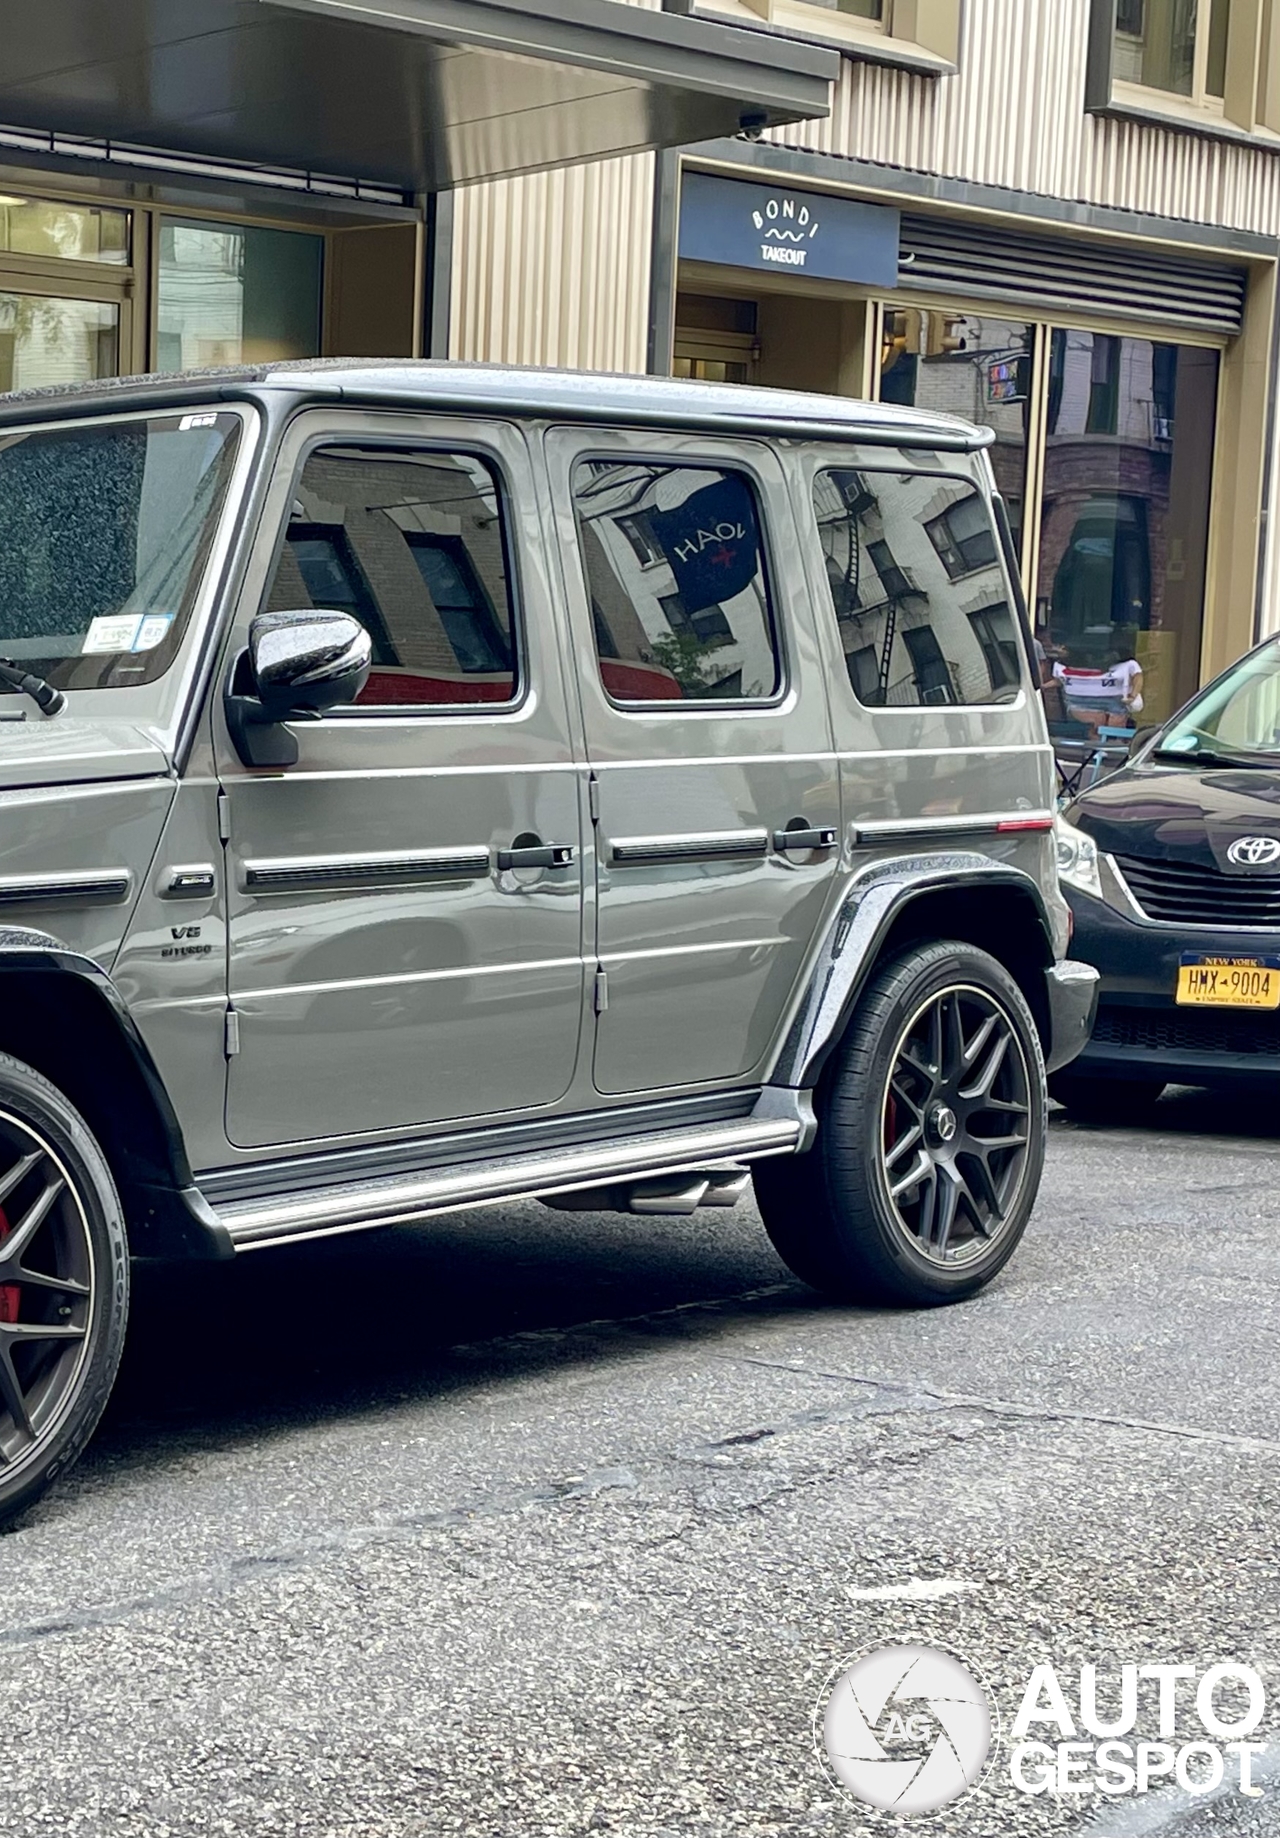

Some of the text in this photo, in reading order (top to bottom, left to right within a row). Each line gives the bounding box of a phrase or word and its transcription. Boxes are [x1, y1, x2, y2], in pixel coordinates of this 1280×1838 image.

[752, 199, 819, 238] BONDI
[761, 245, 807, 265] TAKEOUT
[1205, 957, 1258, 967] NEW YORK
[1188, 969, 1271, 997] HMX 9004
